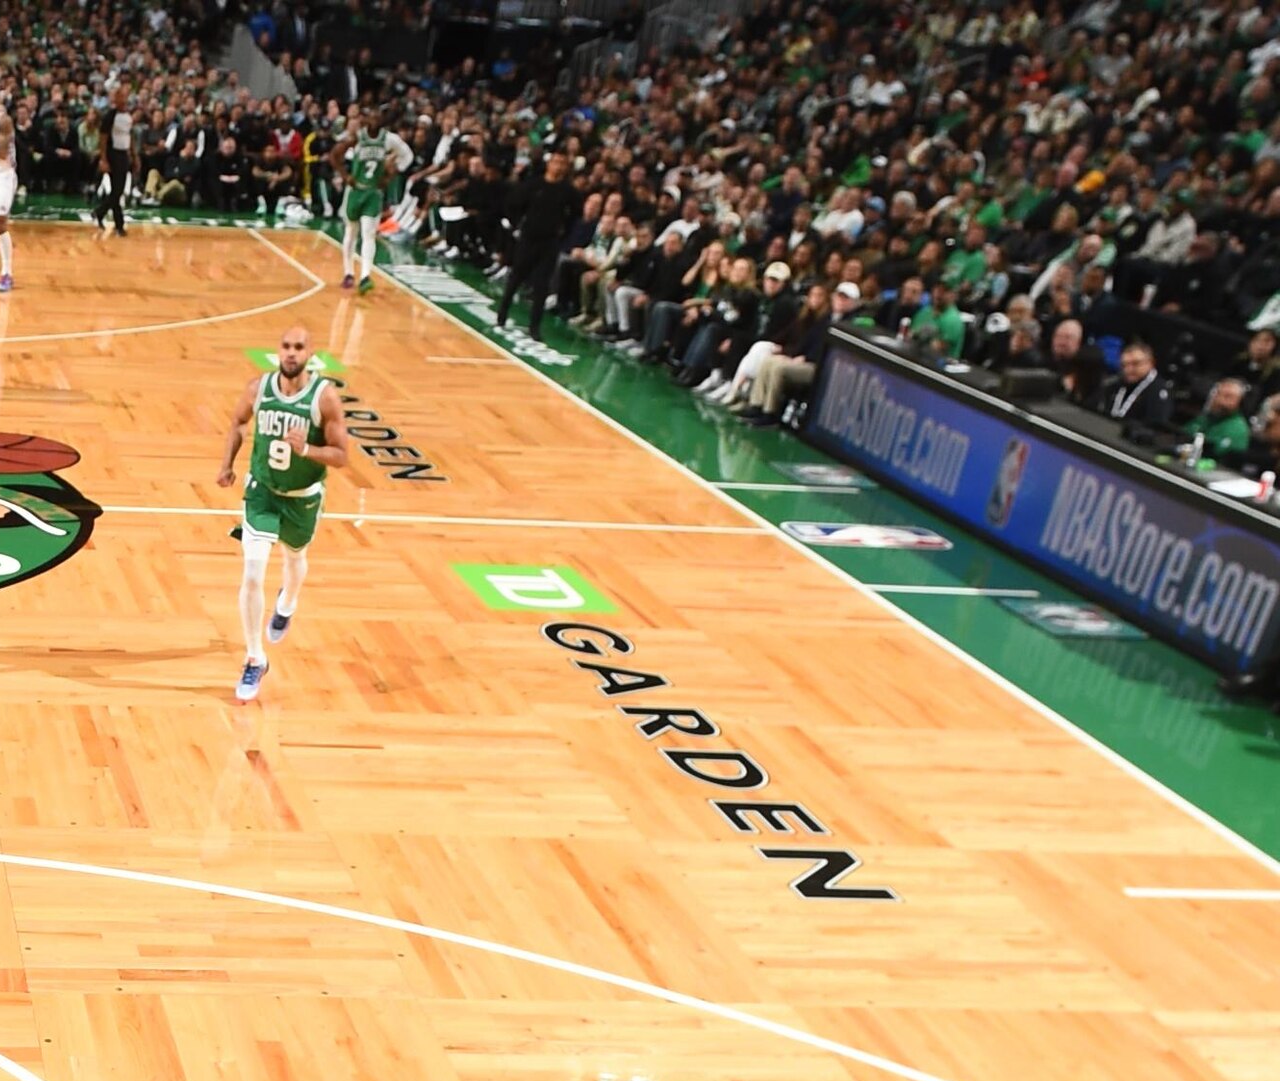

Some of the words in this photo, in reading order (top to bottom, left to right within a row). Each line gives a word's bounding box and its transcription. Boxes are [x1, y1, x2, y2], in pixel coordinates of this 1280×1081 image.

[364, 160, 378, 179] 7
[267, 439, 292, 471] 9
[324, 376, 450, 483] RDEN
[1041, 464, 1280, 656] NBAStore.com
[485, 569, 586, 608] TD
[538, 620, 907, 903] GARDEN
